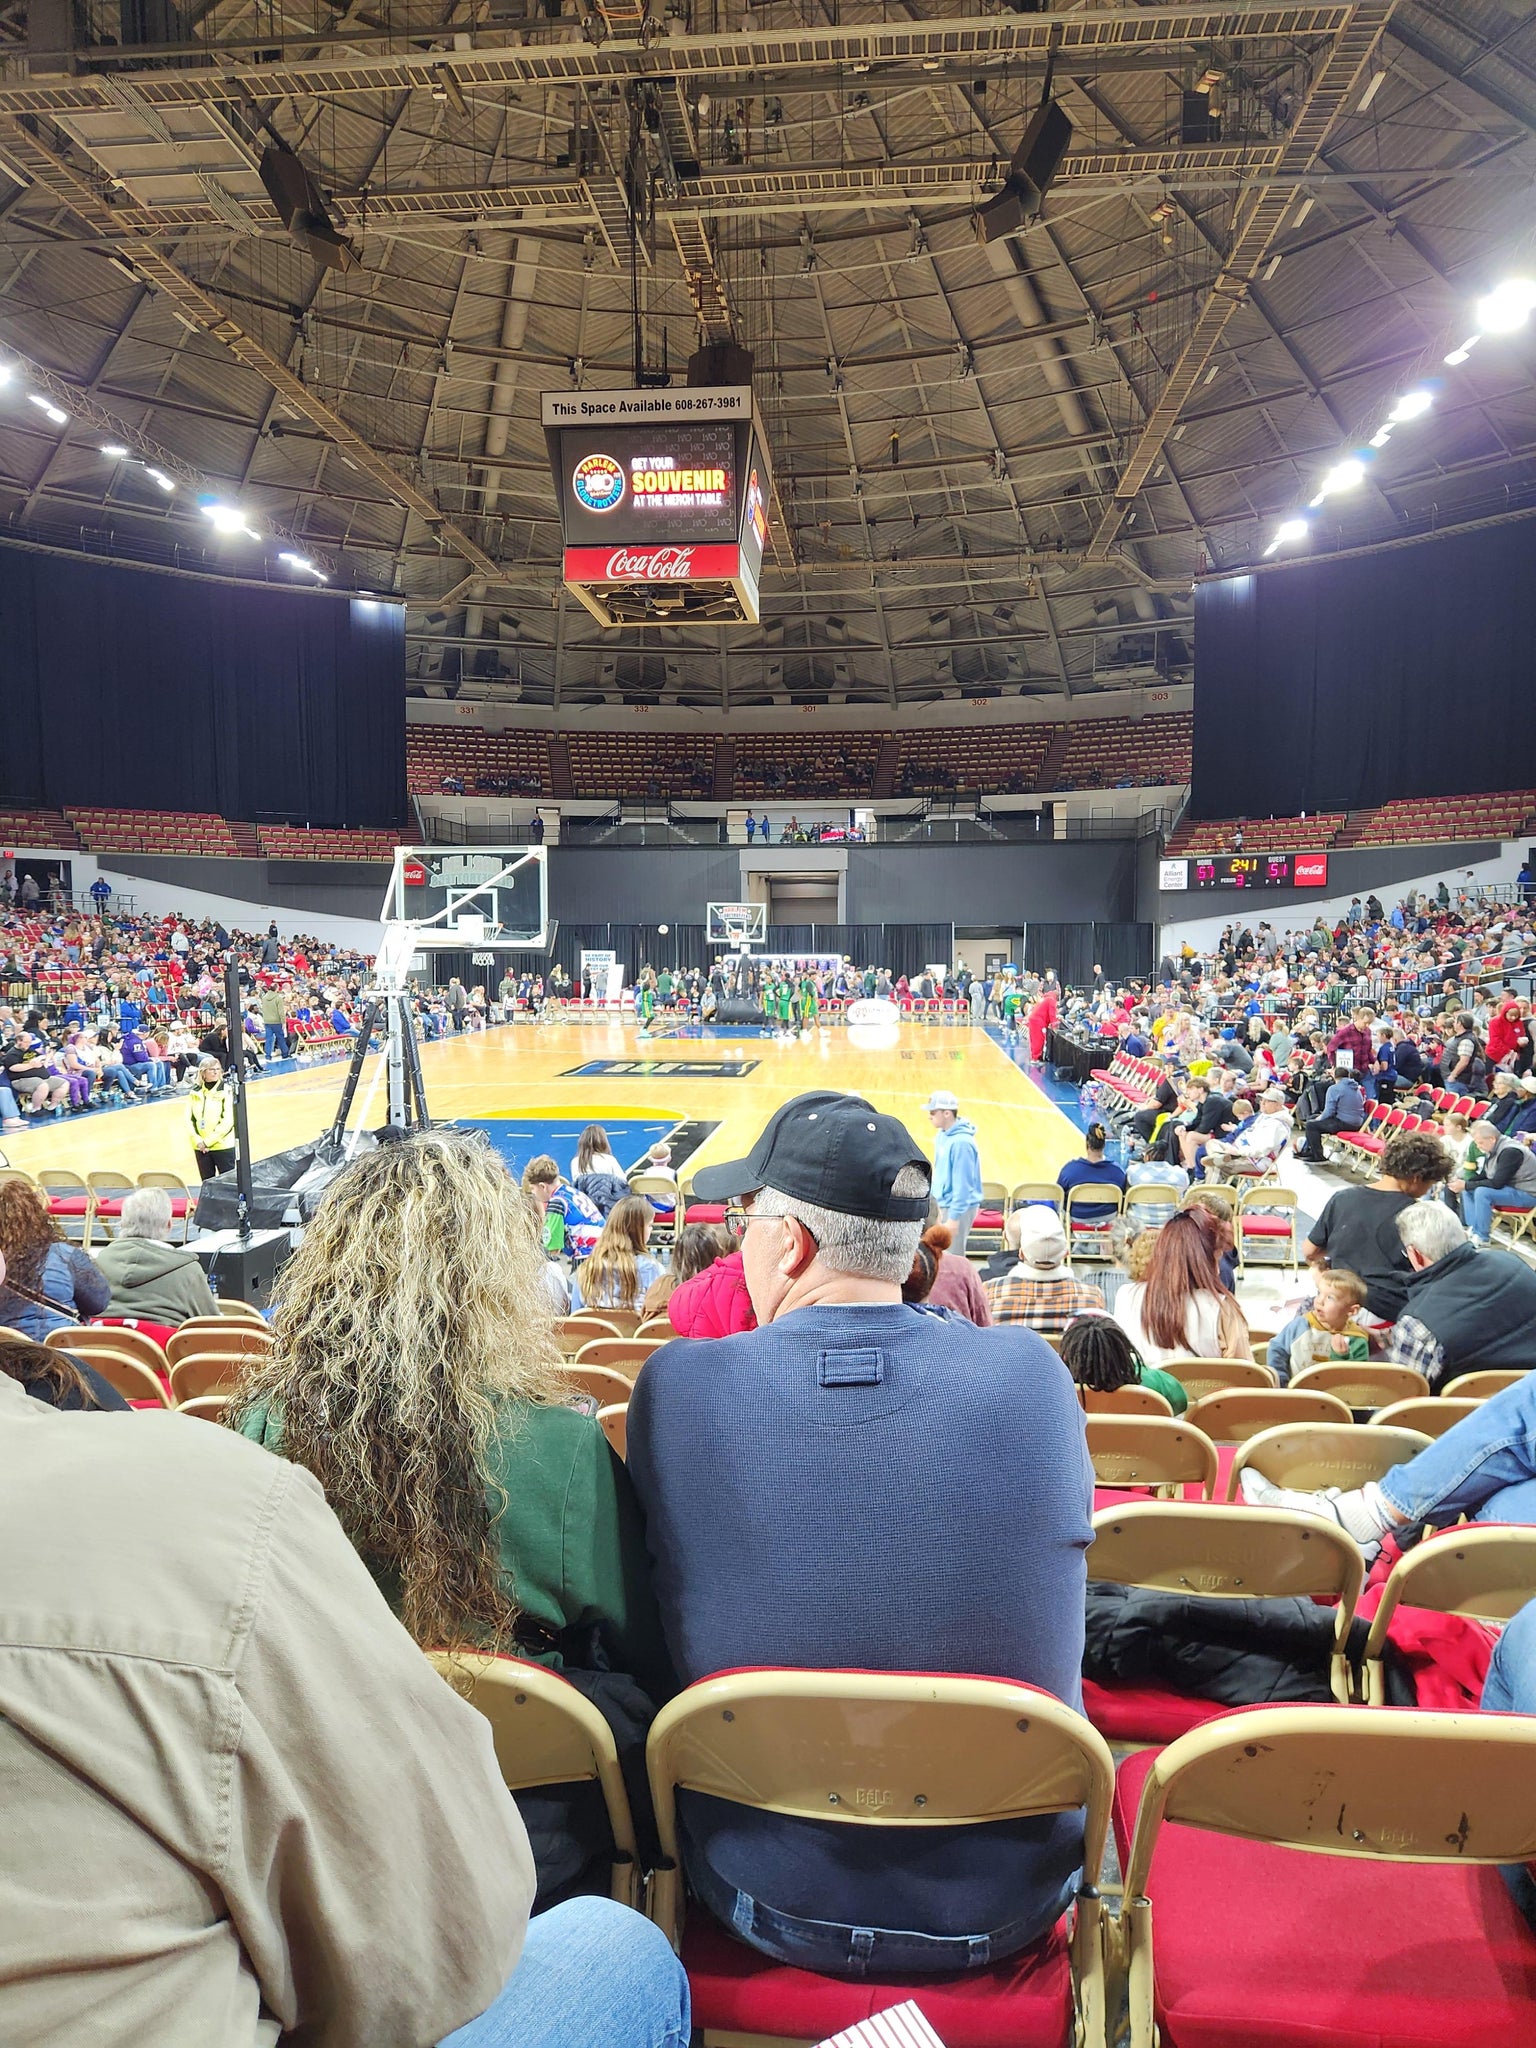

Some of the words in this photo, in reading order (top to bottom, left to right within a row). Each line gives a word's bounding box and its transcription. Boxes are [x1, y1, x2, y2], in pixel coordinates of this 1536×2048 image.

[552, 403, 577, 416] This
[581, 401, 616, 416] Space
[619, 399, 672, 413] Available
[675, 397, 741, 410] 608-267-3981
[581, 457, 617, 473] HARLEM
[631, 458, 648, 470] GET
[649, 457, 674, 469] YOUR
[631, 469, 725, 493] SOUVENIR
[633, 494, 646, 507] AT
[647, 494, 663, 507] THE
[664, 493, 693, 507] MERCH
[694, 492, 722, 506] TABLE
[606, 548, 695, 579] Coca-Cola
[971, 698, 988, 707] 302
[1151, 692, 1169, 701] 303
[459, 706, 475, 715] 331
[634, 705, 649, 713] 332
[802, 705, 817, 713] 301
[1197, 865, 1215, 879] 57
[1230, 858, 1258, 873] 2:41
[1269, 863, 1288, 877] 51
[1164, 876, 1183, 884] Energy
